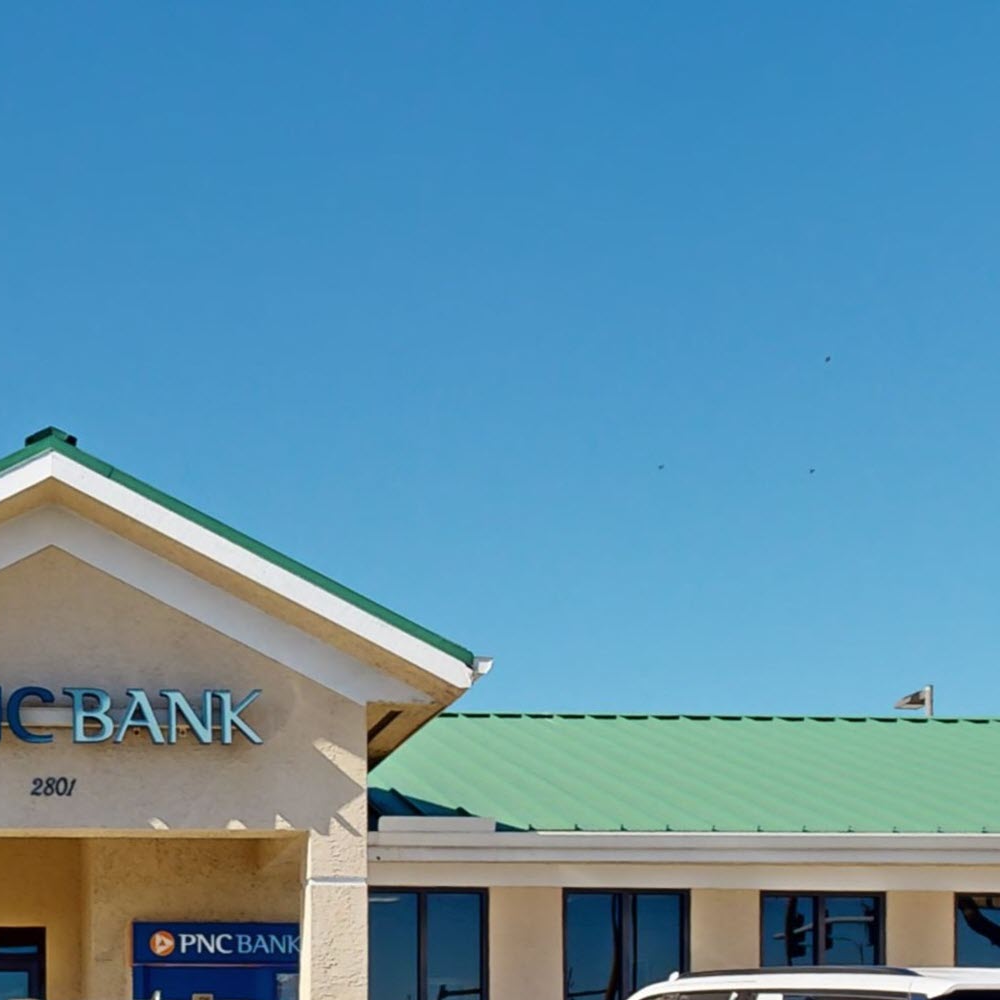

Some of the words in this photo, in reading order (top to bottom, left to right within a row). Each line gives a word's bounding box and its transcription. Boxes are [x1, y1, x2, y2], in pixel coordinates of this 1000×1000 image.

[62, 687, 264, 744] BANK
[30, 776, 77, 797] 2801
[178, 933, 233, 954] PNC
[235, 933, 301, 954] BANK
